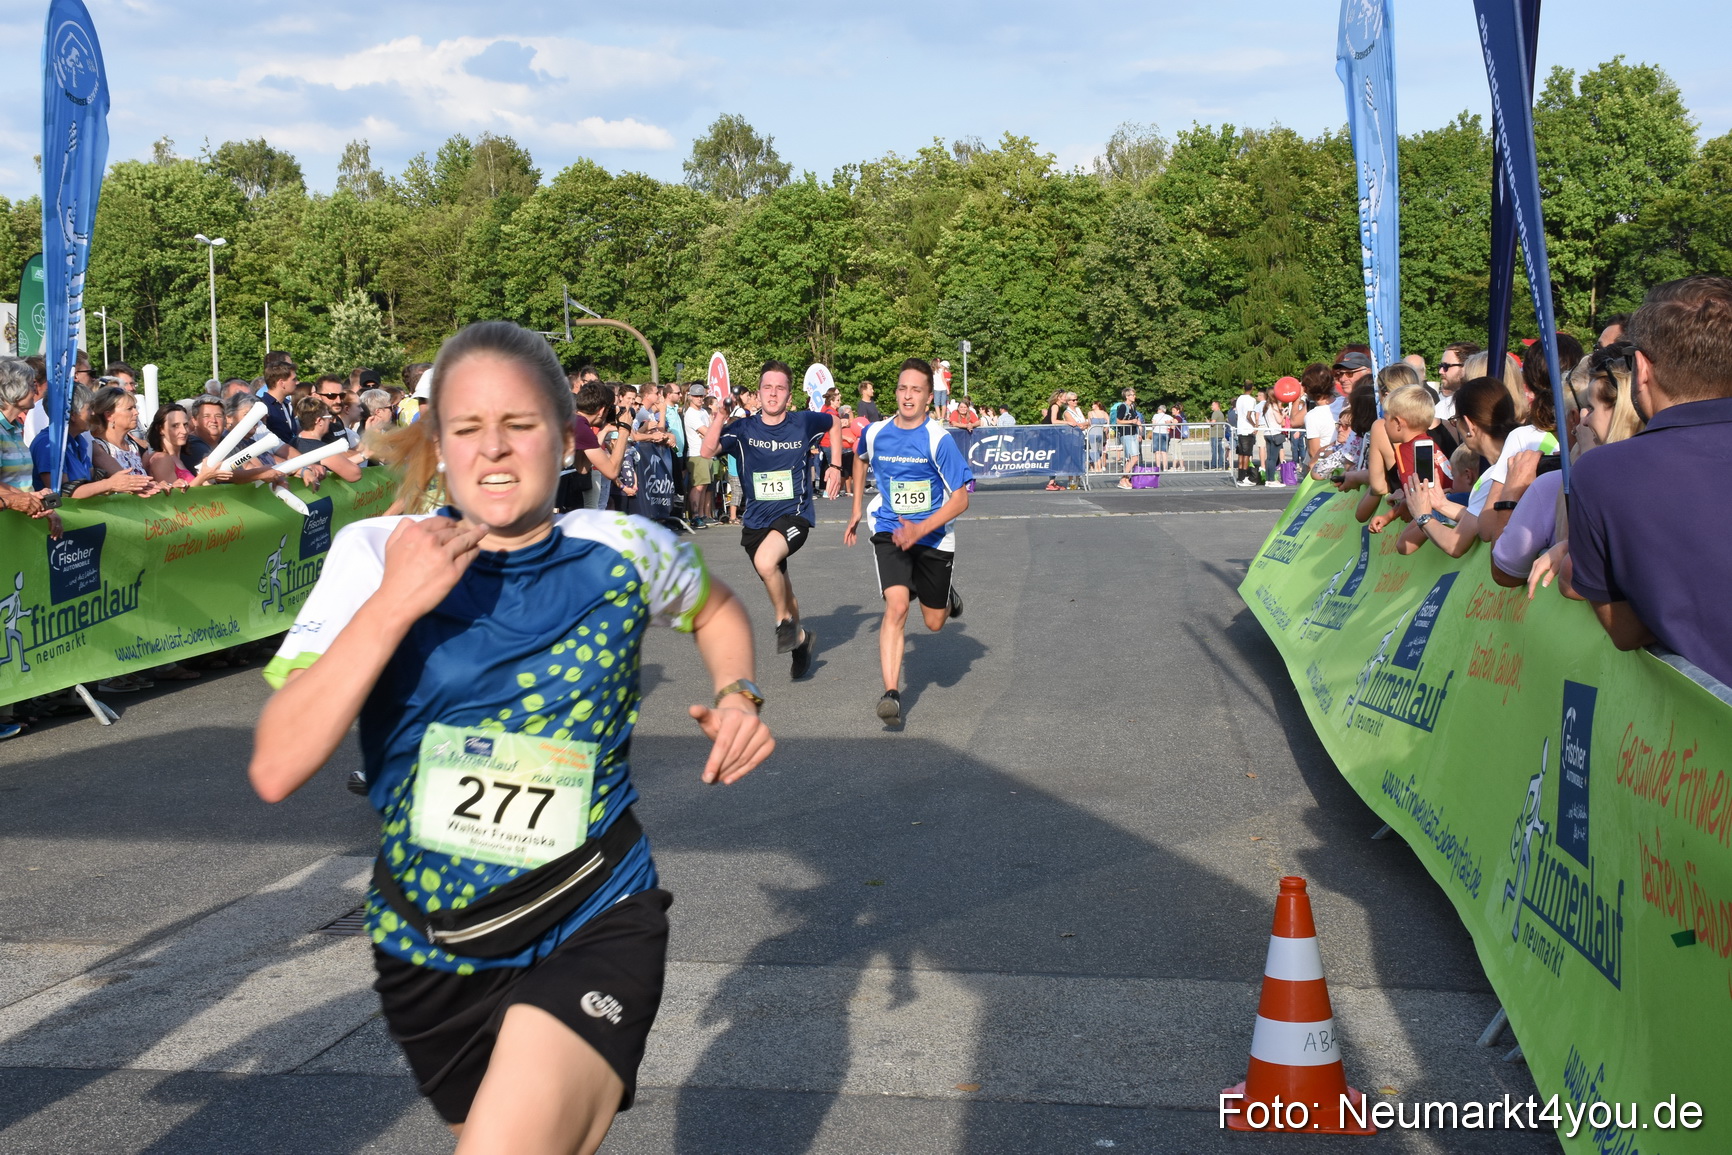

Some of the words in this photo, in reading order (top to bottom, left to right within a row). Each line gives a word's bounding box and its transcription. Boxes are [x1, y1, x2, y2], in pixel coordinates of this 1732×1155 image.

[748, 437, 771, 449] EURO
[778, 440, 802, 450] POLES
[984, 446, 1056, 463] Fischer
[990, 462, 1050, 471] AUTOMOBILE
[761, 481, 784, 493] 713
[894, 491, 926, 504] 2159
[144, 505, 193, 541] Gesunde
[187, 501, 229, 524] Firmen
[307, 516, 328, 530] Fischer
[58, 547, 94, 566] Fischer
[164, 533, 202, 563] laufen
[287, 557, 325, 592] firme
[31, 568, 146, 647] firmenlauf
[36, 631, 86, 664] neumarkt
[1362, 654, 1454, 733] firmenlauf
[1354, 713, 1385, 737] neumarkt
[1564, 735, 1586, 770] Fischer
[1617, 720, 1676, 808] Gesunde
[453, 775, 555, 829] 277
[491, 827, 556, 847] Franziska
[1530, 821, 1624, 991] firmenlauf
[1522, 922, 1566, 979] neumarkt
